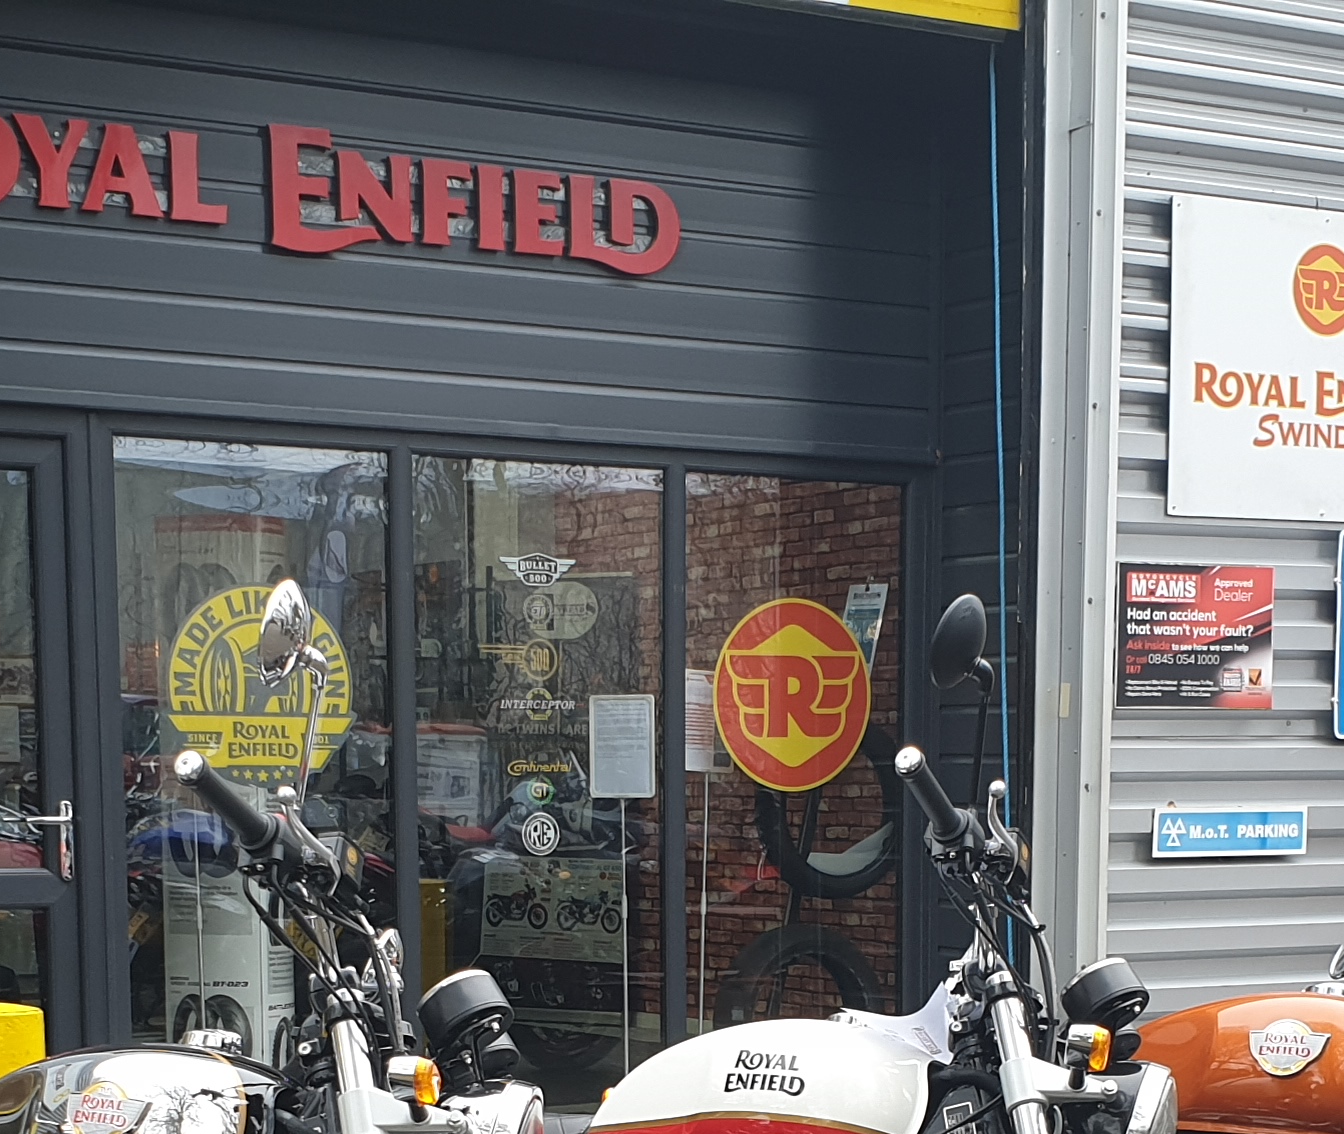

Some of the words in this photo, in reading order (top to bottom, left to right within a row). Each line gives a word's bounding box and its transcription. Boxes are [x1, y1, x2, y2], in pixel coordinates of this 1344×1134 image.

[266, 123, 681, 276] ENFIELD
[1193, 361, 1306, 409] ROYAL
[519, 560, 557, 573] BULLET
[1214, 578, 1254, 589] Approved
[1214, 588, 1254, 602] Dealer
[1127, 608, 1151, 621] Had
[1152, 611, 1167, 621] an
[1169, 610, 1217, 622] accident
[1126, 623, 1151, 635] that
[1153, 624, 1190, 636] wasn't
[1192, 627, 1218, 639] your
[1220, 624, 1254, 637] fault?
[174, 606, 223, 697] MADE
[224, 590, 270, 620] LIK
[1126, 640, 1143, 650] Ask
[1144, 640, 1170, 650] inside
[1171, 643, 1179, 651] to
[1234, 643, 1249, 654] help
[530, 648, 550, 671] 500
[1148, 654, 1174, 665] 0845
[1175, 654, 1195, 665] 054
[1197, 654, 1220, 665] 1000
[500, 699, 576, 710] INTERCEPTOR
[188, 733, 218, 743] SINCE
[233, 721, 290, 740] ROYAL
[228, 742, 299, 759] ENFIELD
[508, 760, 572, 776] Continental
[531, 782, 549, 798] GT
[1236, 823, 1299, 839] PARKING
[1264, 1032, 1307, 1045] ROYAL
[1258, 1045, 1311, 1058] ENFIELD
[734, 1049, 799, 1071] ROYAL
[723, 1073, 805, 1097] ENFIELD
[81, 1094, 124, 1111] ROYAL
[73, 1110, 127, 1128] ENFIELD
